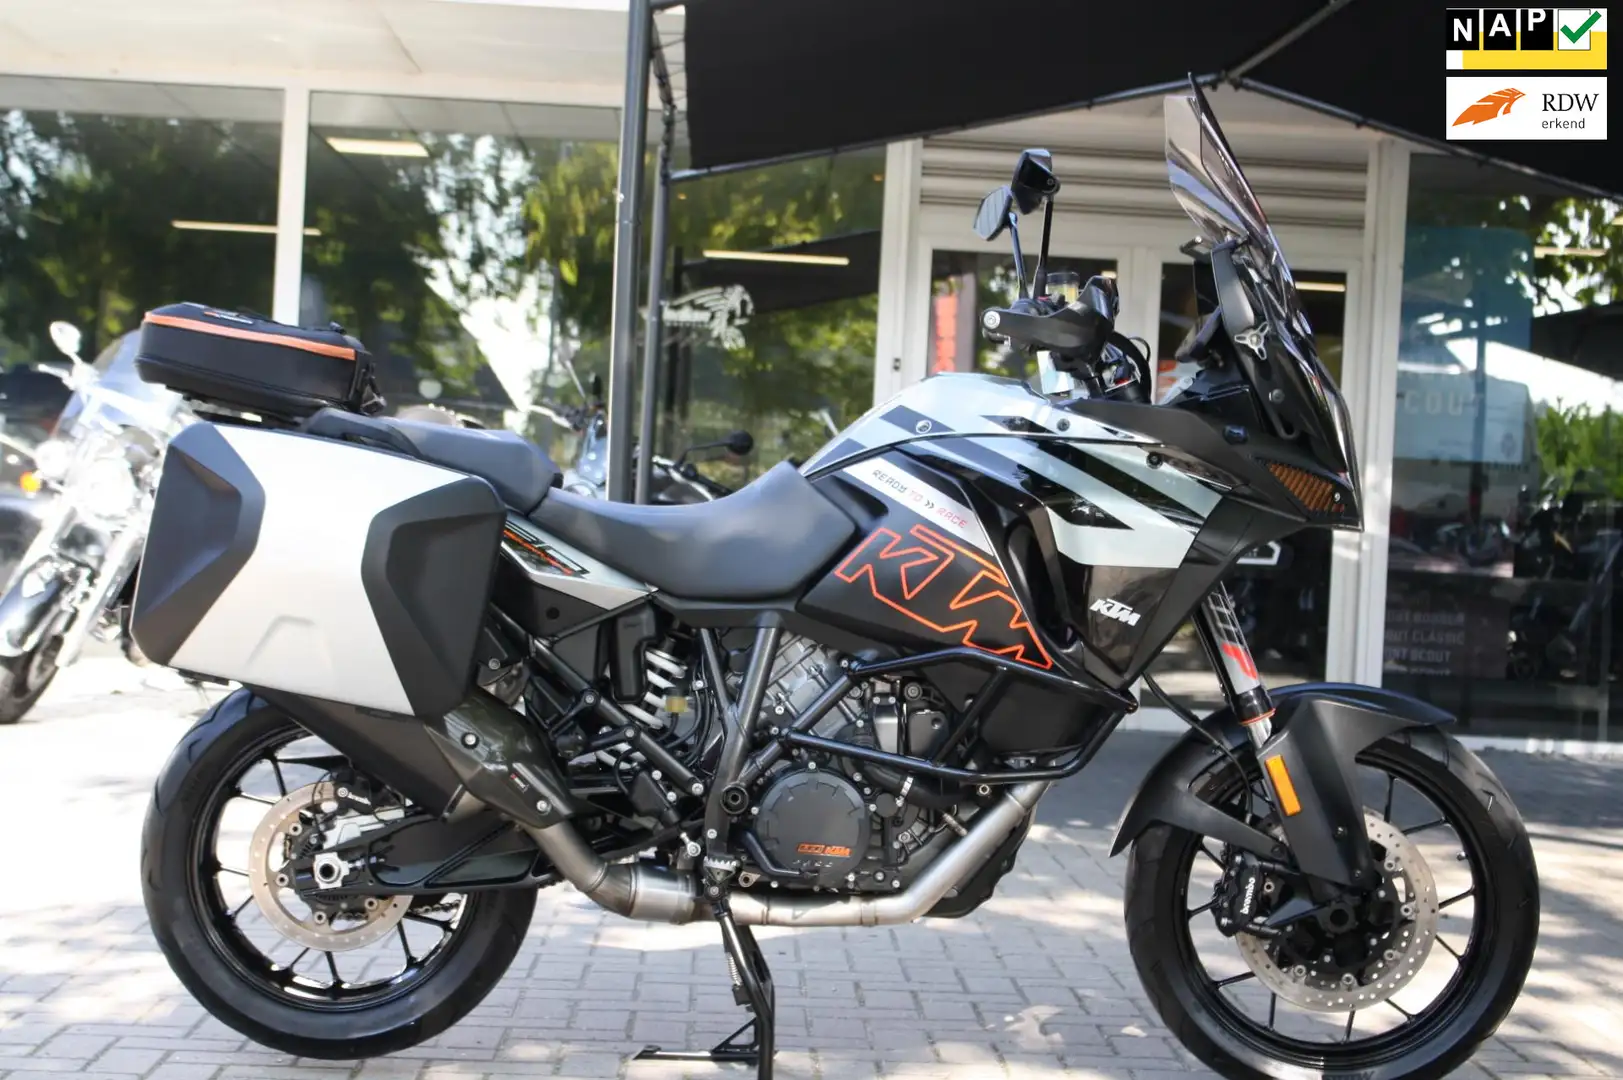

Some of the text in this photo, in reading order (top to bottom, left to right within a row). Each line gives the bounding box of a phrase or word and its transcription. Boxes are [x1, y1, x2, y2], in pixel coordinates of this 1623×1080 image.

[872, 469, 969, 528] READY TO RACE
[834, 523, 1053, 669] KTM
[1089, 598, 1141, 627] KTM
